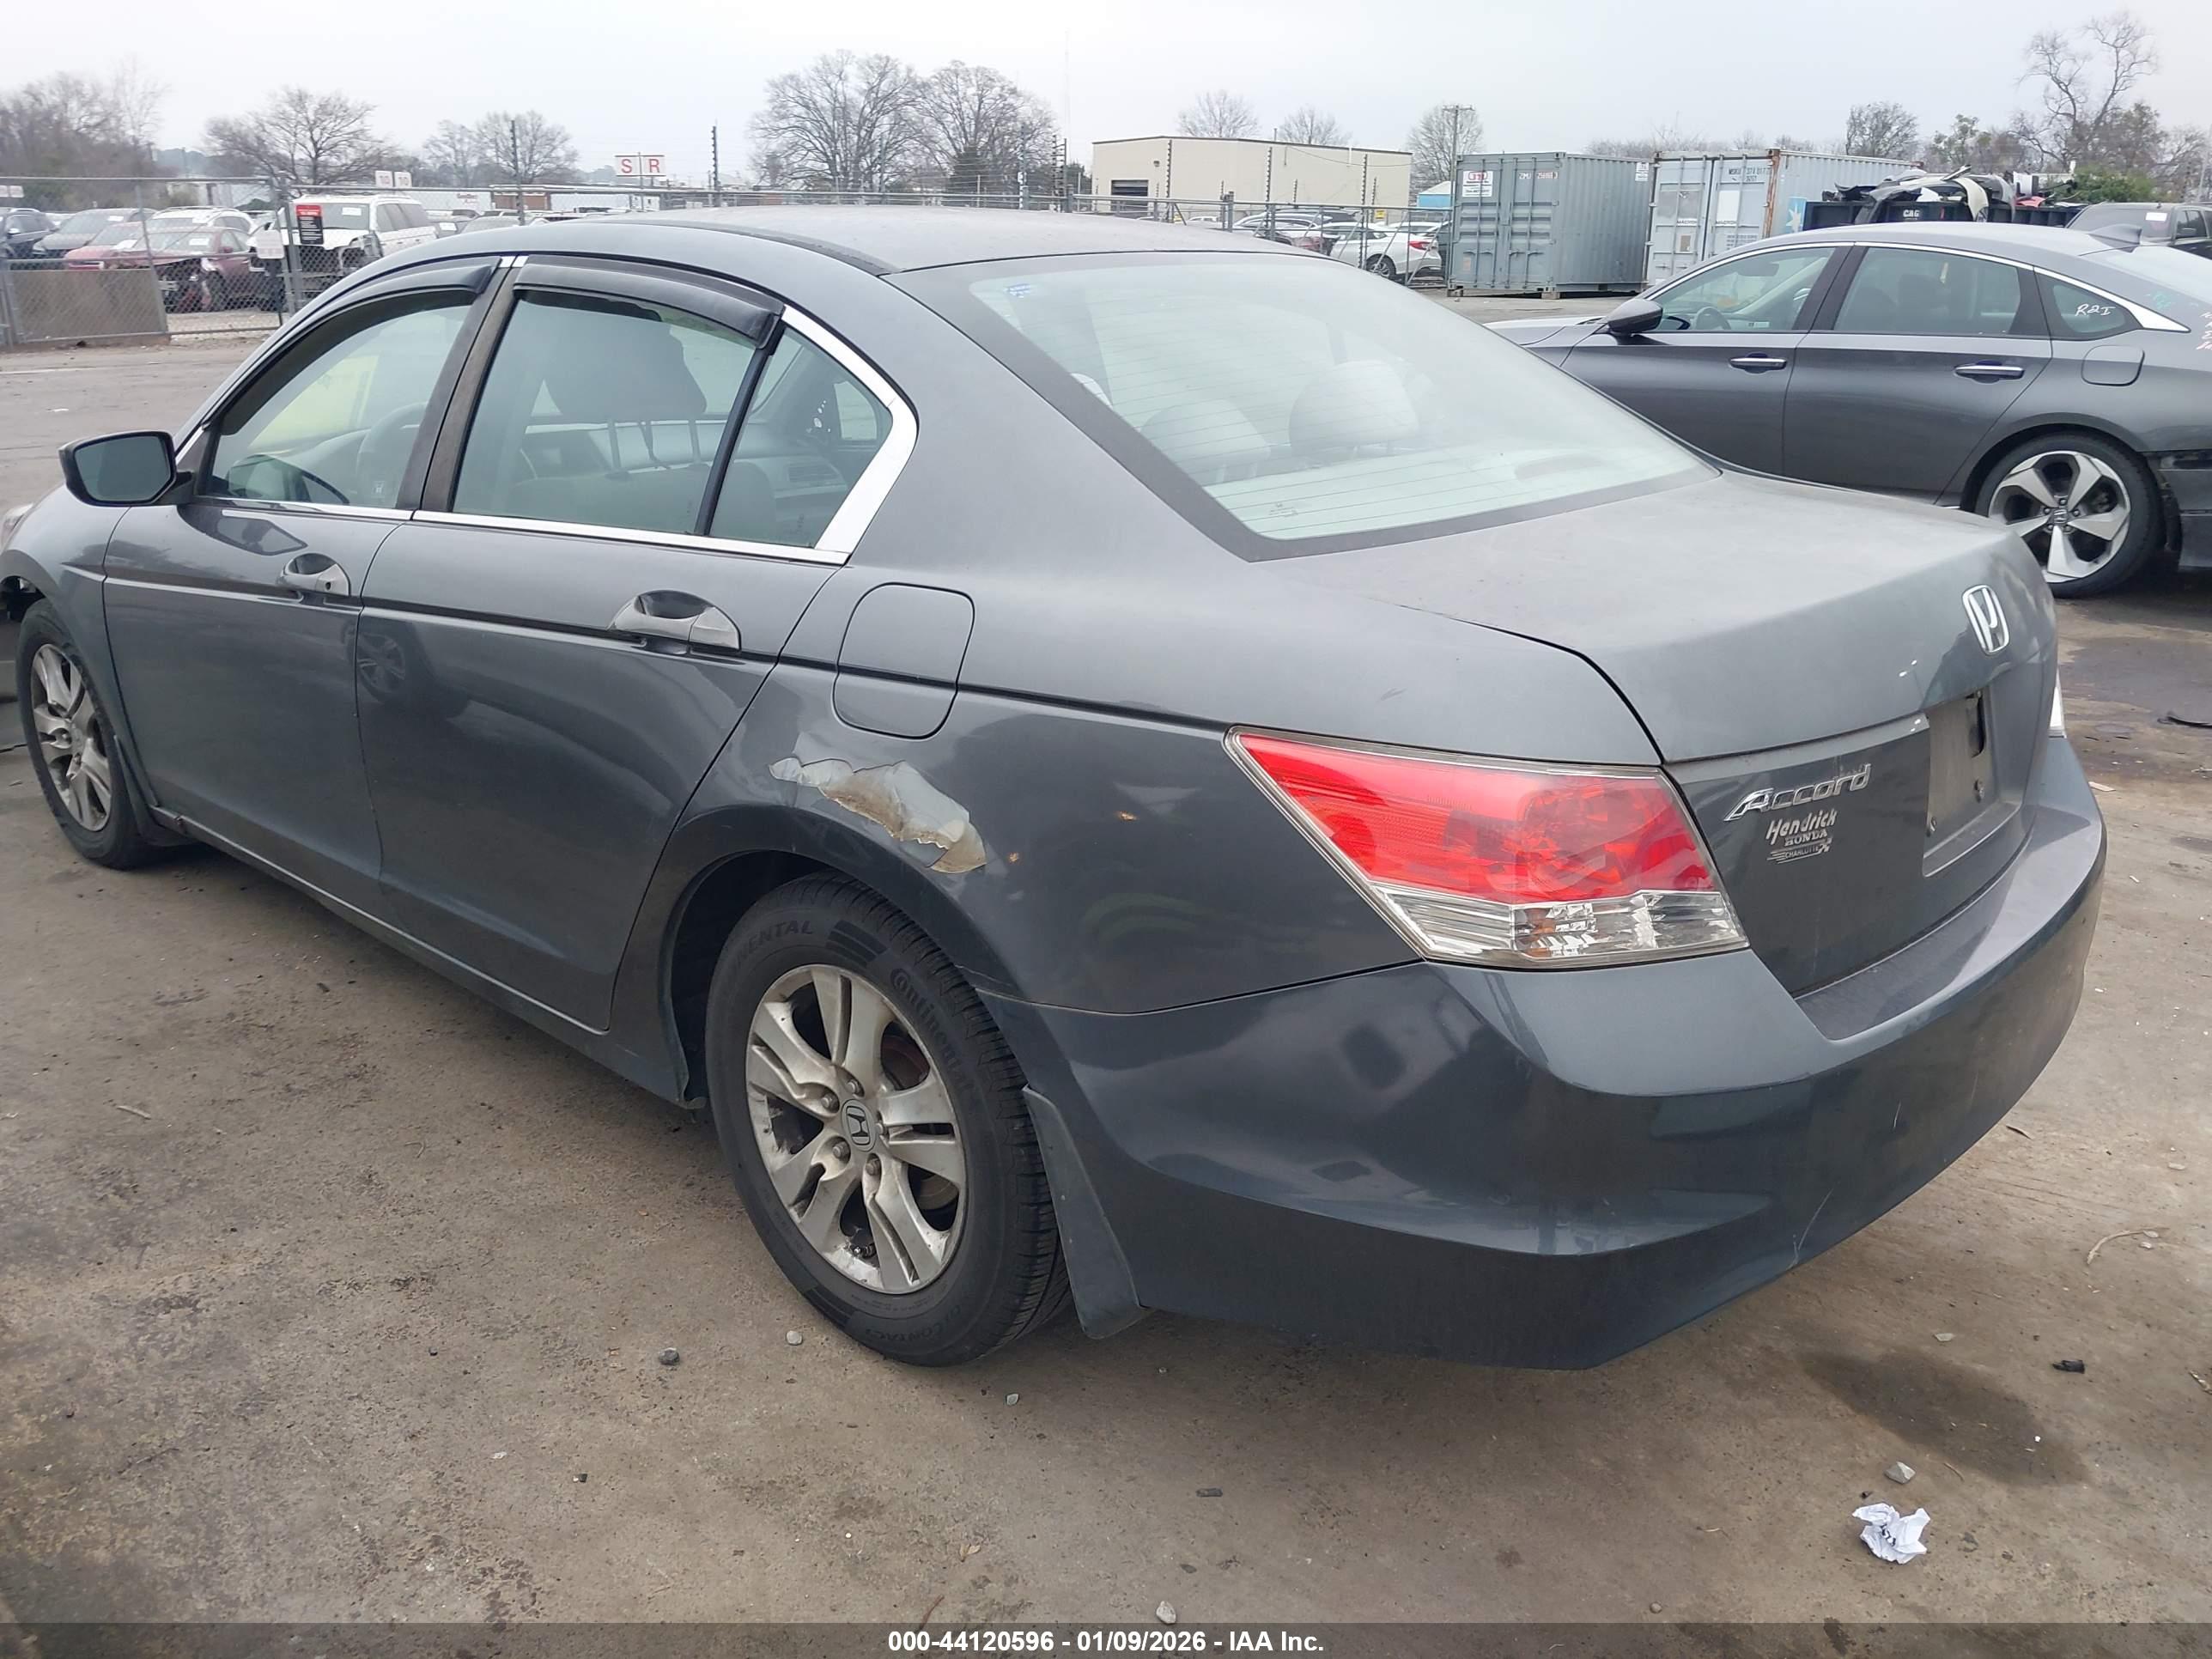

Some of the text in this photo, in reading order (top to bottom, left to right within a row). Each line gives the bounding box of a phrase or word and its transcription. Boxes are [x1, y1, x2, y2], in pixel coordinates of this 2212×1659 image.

[621, 158, 660, 173] S R
[1723, 763, 1871, 822] Accord
[1765, 808, 1838, 846] Hendrick
[1784, 829, 1828, 847] HONDA
[1784, 845, 1820, 859] CHARLOTTE
